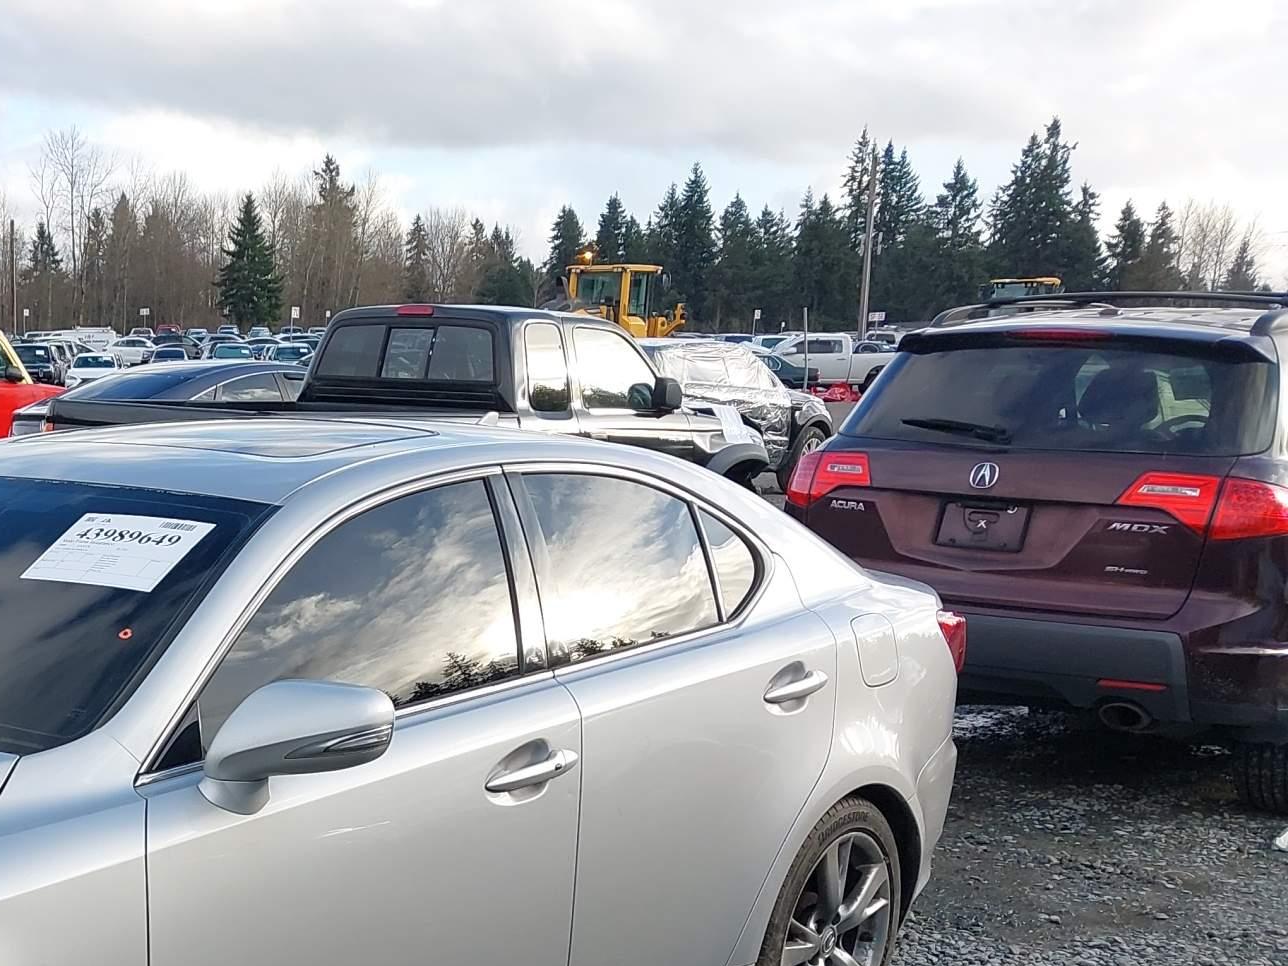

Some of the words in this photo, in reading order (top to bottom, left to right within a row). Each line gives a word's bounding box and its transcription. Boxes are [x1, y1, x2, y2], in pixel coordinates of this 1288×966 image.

[830, 499, 865, 511] ACURA
[1106, 522, 1170, 535] MDX
[75, 527, 182, 547] 43989649
